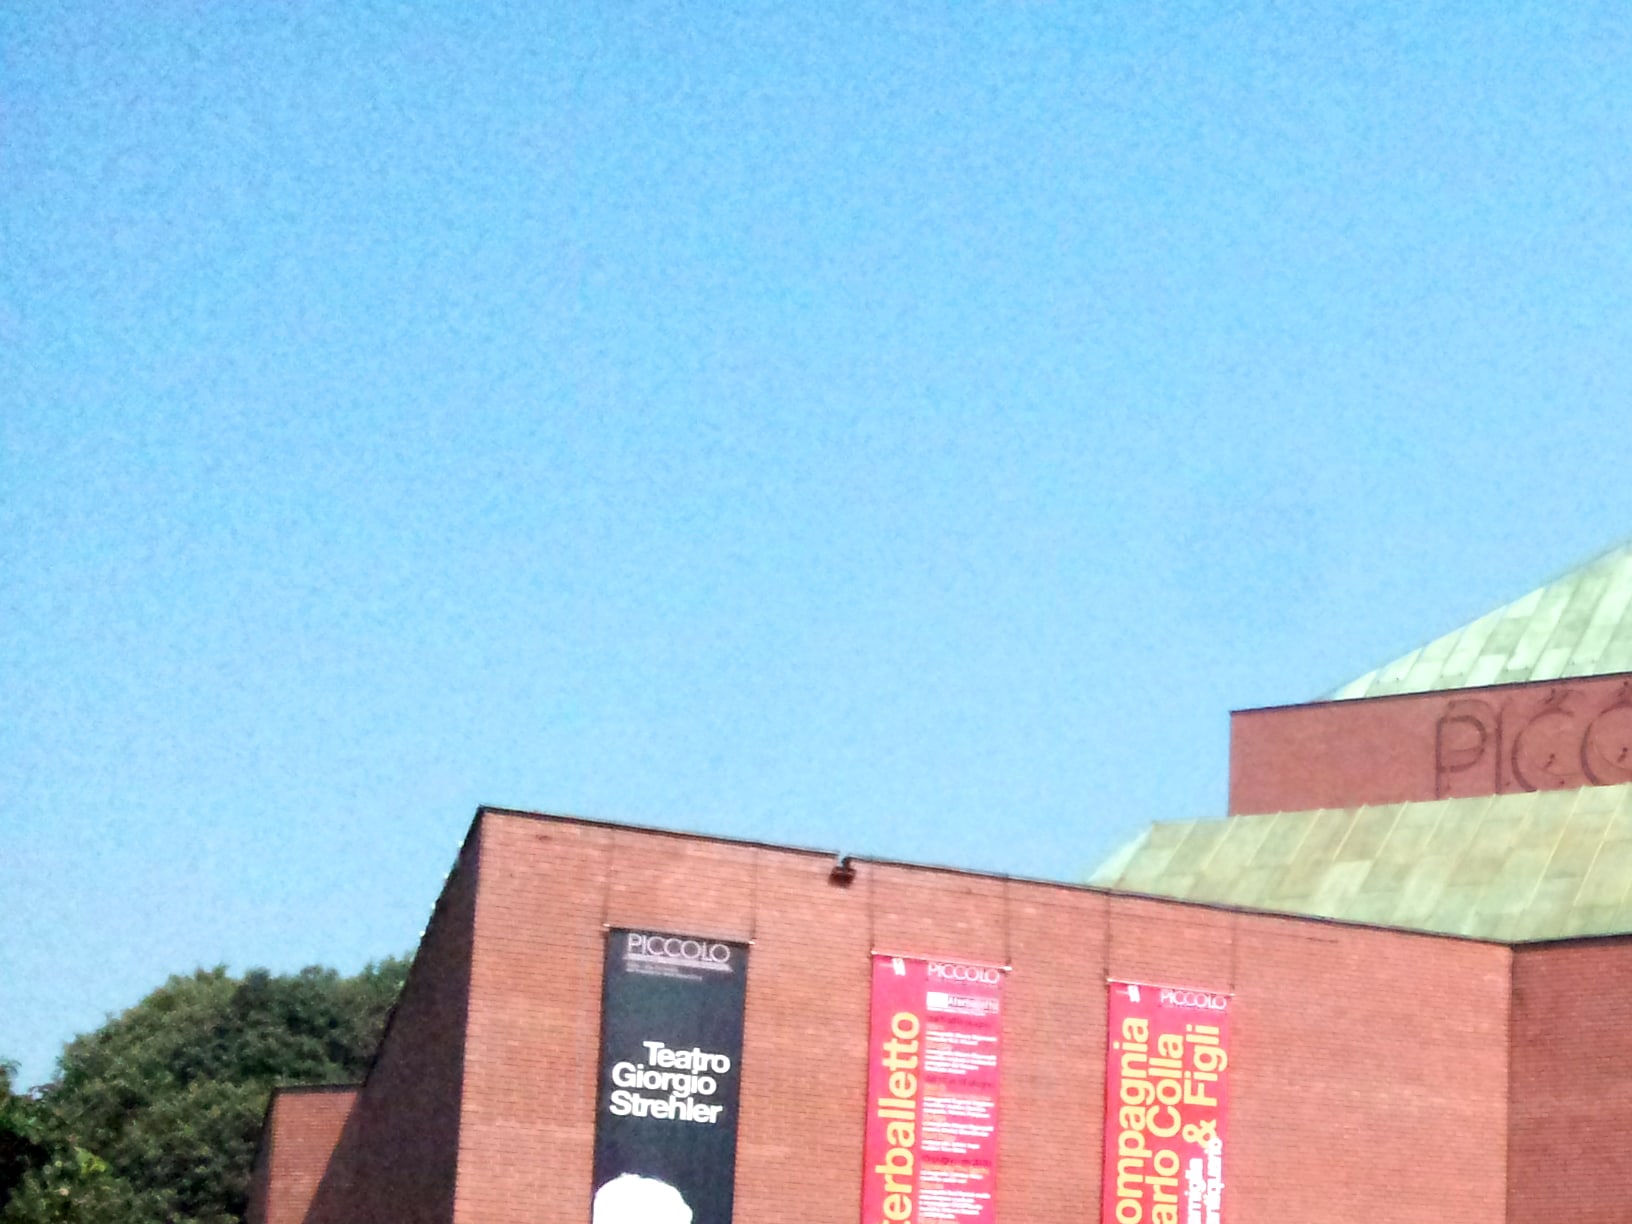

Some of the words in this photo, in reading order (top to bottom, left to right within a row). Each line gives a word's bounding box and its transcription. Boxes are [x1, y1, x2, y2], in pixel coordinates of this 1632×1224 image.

[628, 933, 731, 963] PICCOLO
[928, 962, 1000, 984] PICCOLO
[1160, 989, 1227, 1010] PICCOLO
[643, 1041, 730, 1074] Teatro
[1184, 1024, 1228, 1107] Figli
[612, 1062, 717, 1098] Giorgio
[1145, 1033, 1185, 1138] Colla
[610, 1090, 722, 1124] Strehler
[1182, 1119, 1217, 1149] &
